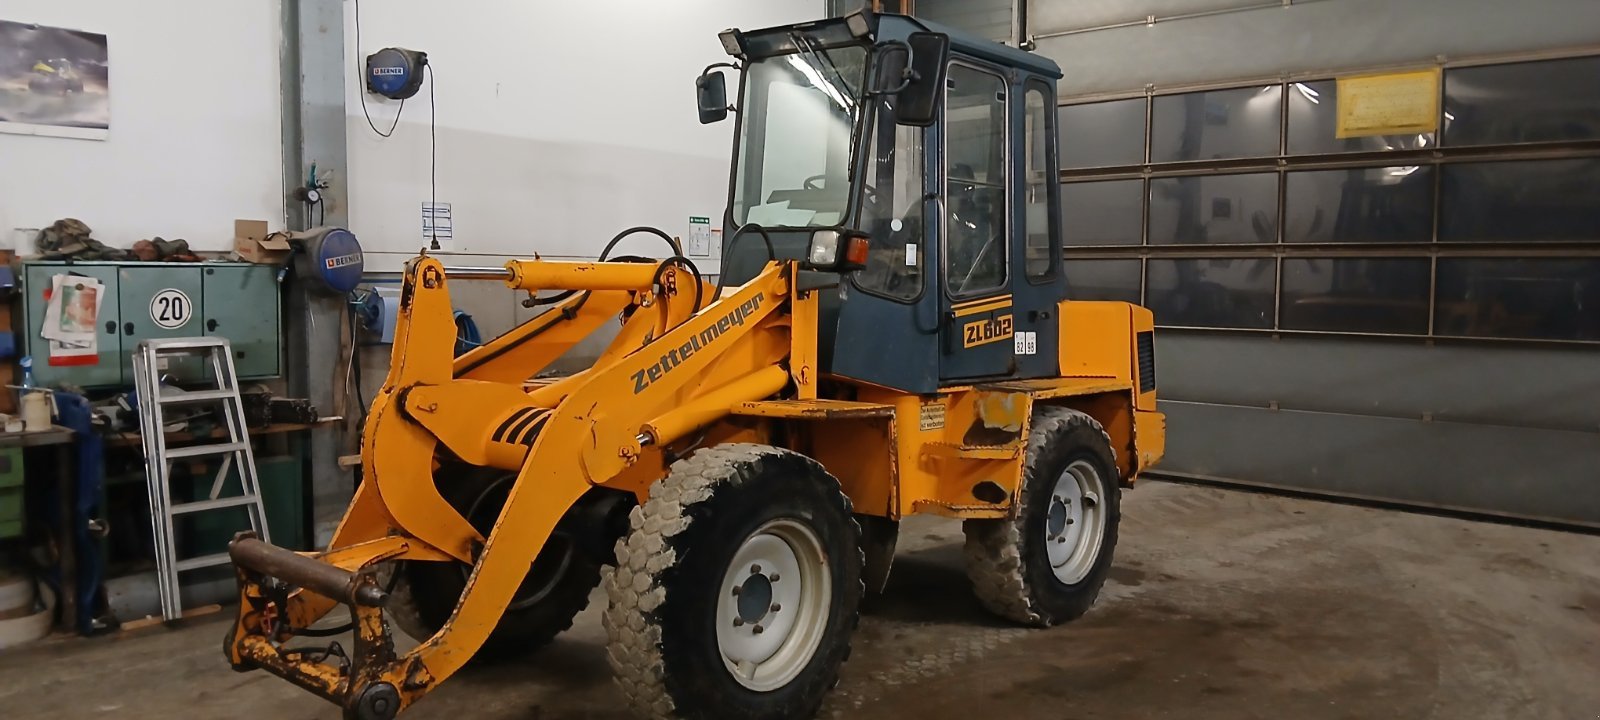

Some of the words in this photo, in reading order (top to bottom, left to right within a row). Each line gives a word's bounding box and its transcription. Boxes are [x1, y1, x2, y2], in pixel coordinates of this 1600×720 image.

[336, 254, 360, 266] BERNER
[159, 297, 182, 320] 20
[966, 318, 1011, 344] ZL602
[630, 292, 765, 395] Zettelmeyer
